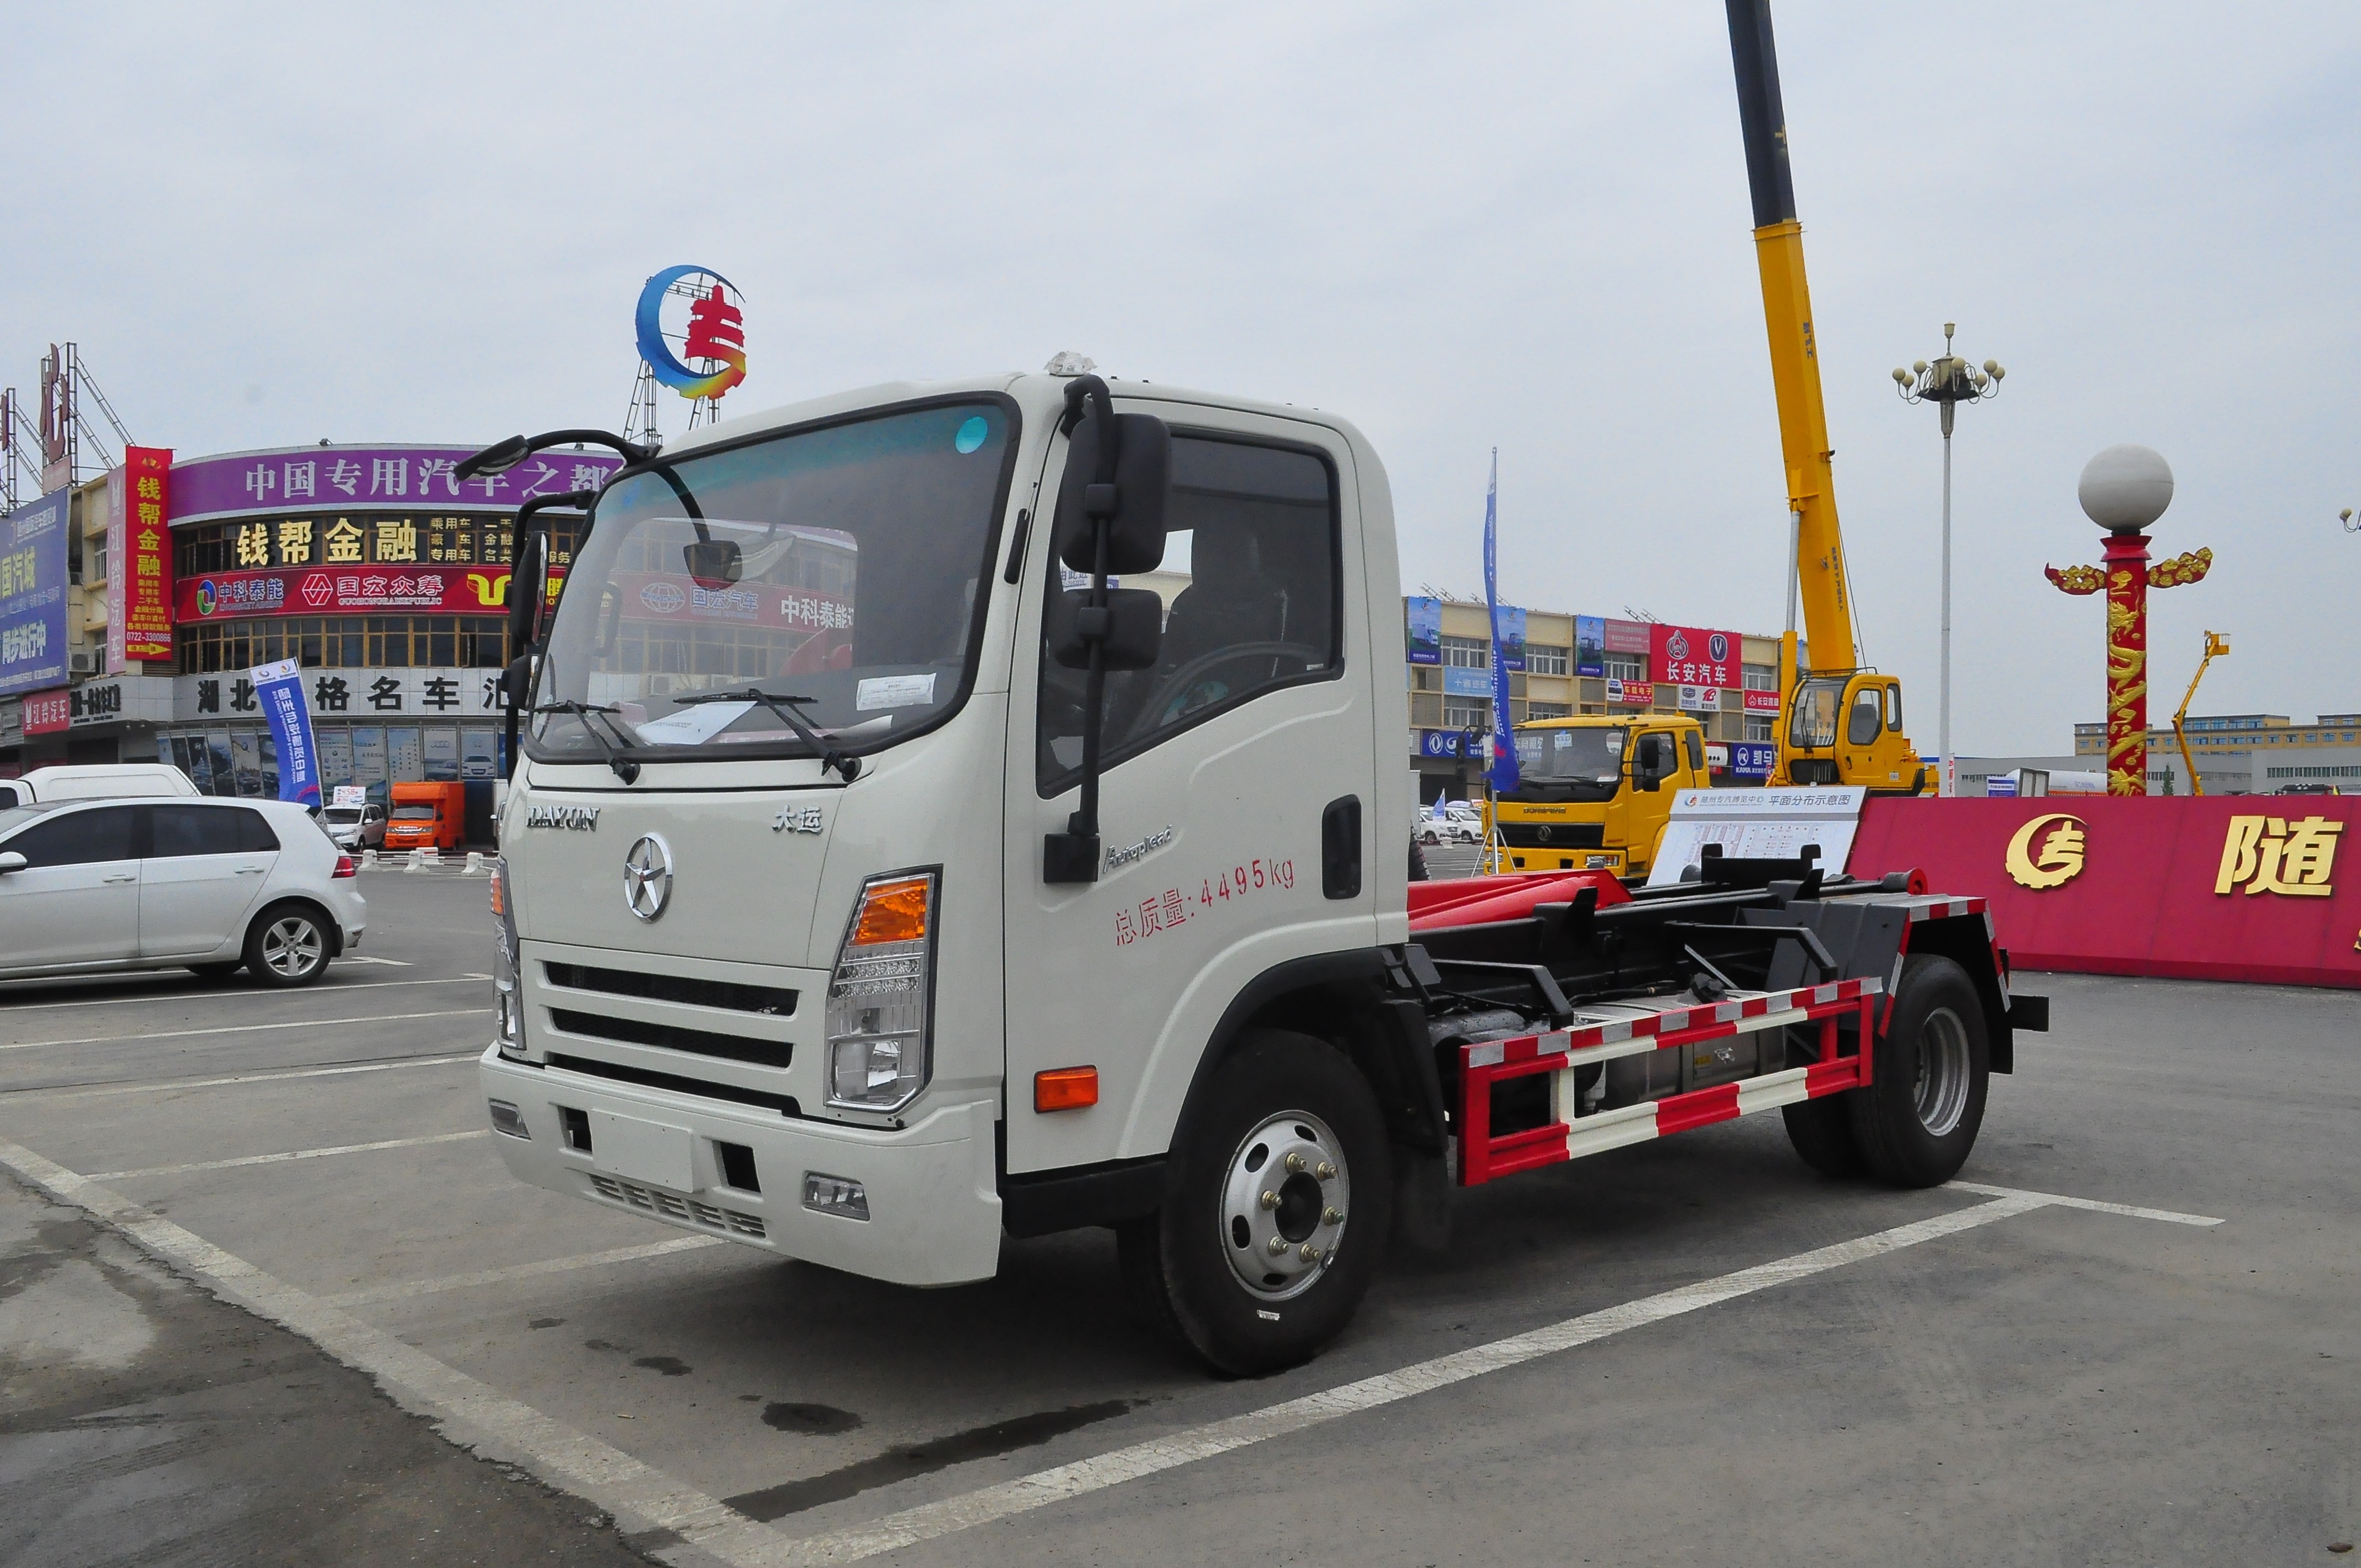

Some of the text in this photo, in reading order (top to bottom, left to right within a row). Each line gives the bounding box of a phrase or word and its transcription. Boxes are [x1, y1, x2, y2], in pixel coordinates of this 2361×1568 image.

[137, 477, 161, 576] 钱帮金融
[431, 518, 471, 530] 乘用车
[237, 516, 417, 566] 钱帮金融
[431, 549, 471, 561] 专用车
[219, 578, 284, 603] 中科泰能
[337, 575, 444, 596] 国宏众筹
[690, 585, 759, 612] 国宏汽车
[1667, 661, 1727, 685] 长安汽车
[198, 676, 509, 712] 湖北格名车汇
[1769, 794, 1851, 806] 平面分布示意图
[527, 805, 600, 831] DAYUN
[772, 805, 823, 835] 大运
[2214, 815, 2344, 896] 随
